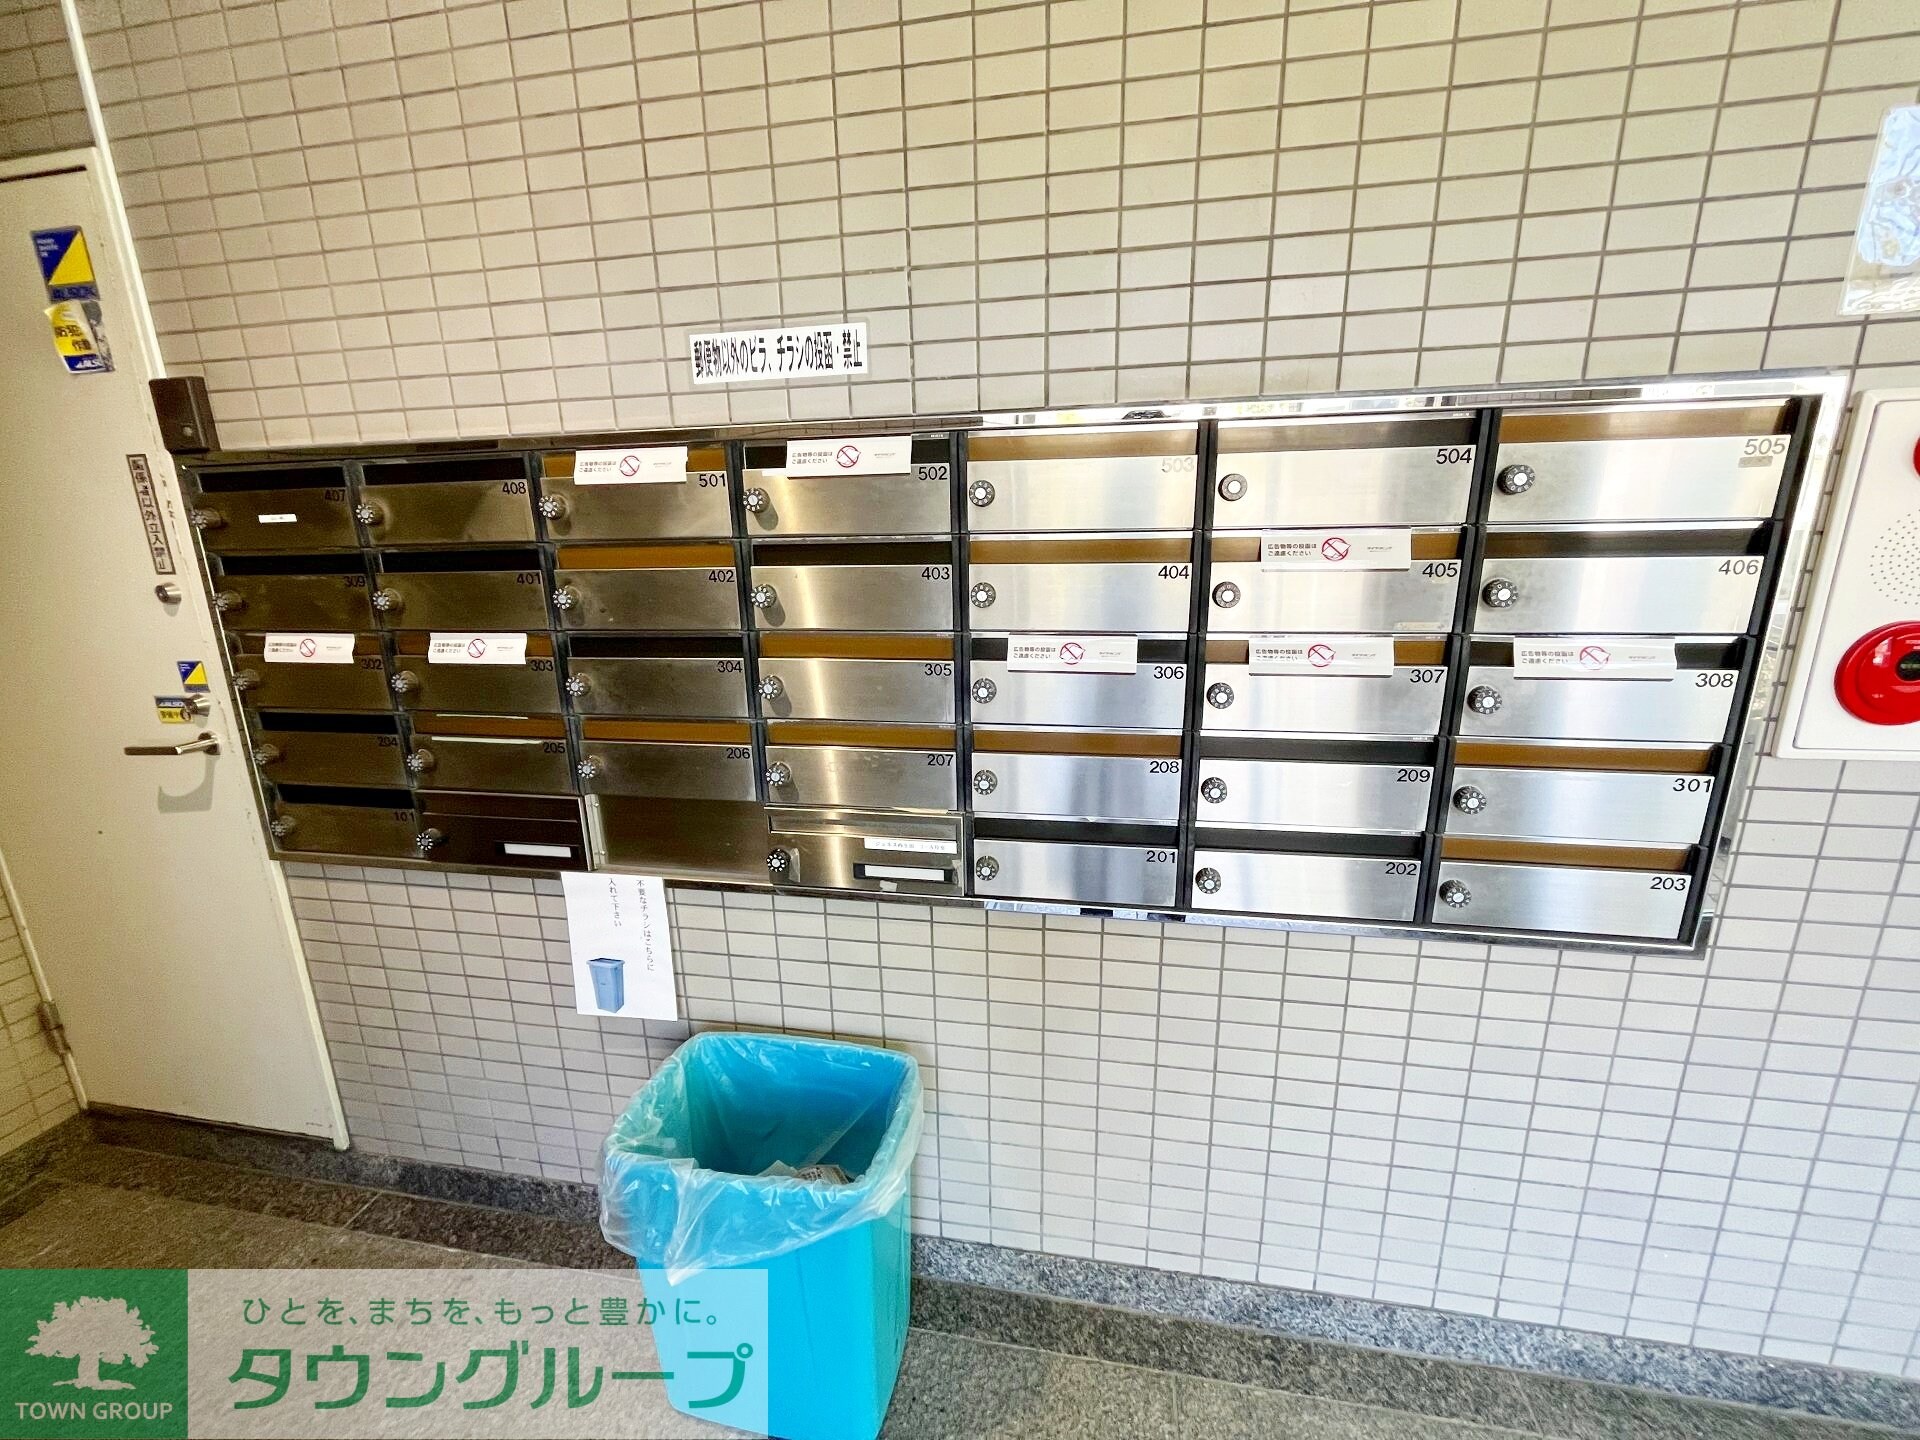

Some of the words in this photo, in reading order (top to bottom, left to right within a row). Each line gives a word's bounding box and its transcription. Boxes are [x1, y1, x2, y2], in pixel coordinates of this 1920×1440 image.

[1744, 439, 1786, 456] 505
[1435, 448, 1472, 464] 504
[1161, 457, 1194, 474] 503
[918, 466, 948, 481] 502
[502, 481, 527, 495] 408
[698, 474, 727, 488] 501
[324, 489, 346, 502] 407
[921, 566, 950, 581] 403
[1157, 564, 1190, 580] 404
[1422, 562, 1458, 578] 405
[1718, 559, 1759, 575] 406
[344, 576, 366, 588] 309
[517, 573, 542, 585] 401
[708, 570, 735, 583] 402
[361, 658, 383, 670] 302
[530, 660, 554, 672] 303
[717, 661, 743, 674] 304
[924, 663, 952, 677] 305
[1153, 665, 1184, 680] 306
[1409, 669, 1445, 684] 307
[1694, 673, 1734, 688] 308
[378, 736, 398, 748] 204
[542, 741, 565, 754] 205
[726, 747, 751, 760] 206
[927, 754, 954, 767] 207
[1149, 760, 1180, 774] 208
[1397, 768, 1431, 783] 209
[1672, 778, 1713, 792] 301
[394, 810, 415, 823] 101
[1146, 850, 1176, 864] 201
[1385, 861, 1418, 876] 202
[1649, 876, 1687, 891] 203
[608, 878, 623, 928] 入れて下さい
[635, 878, 656, 972] 不要なチラシはこちらに
